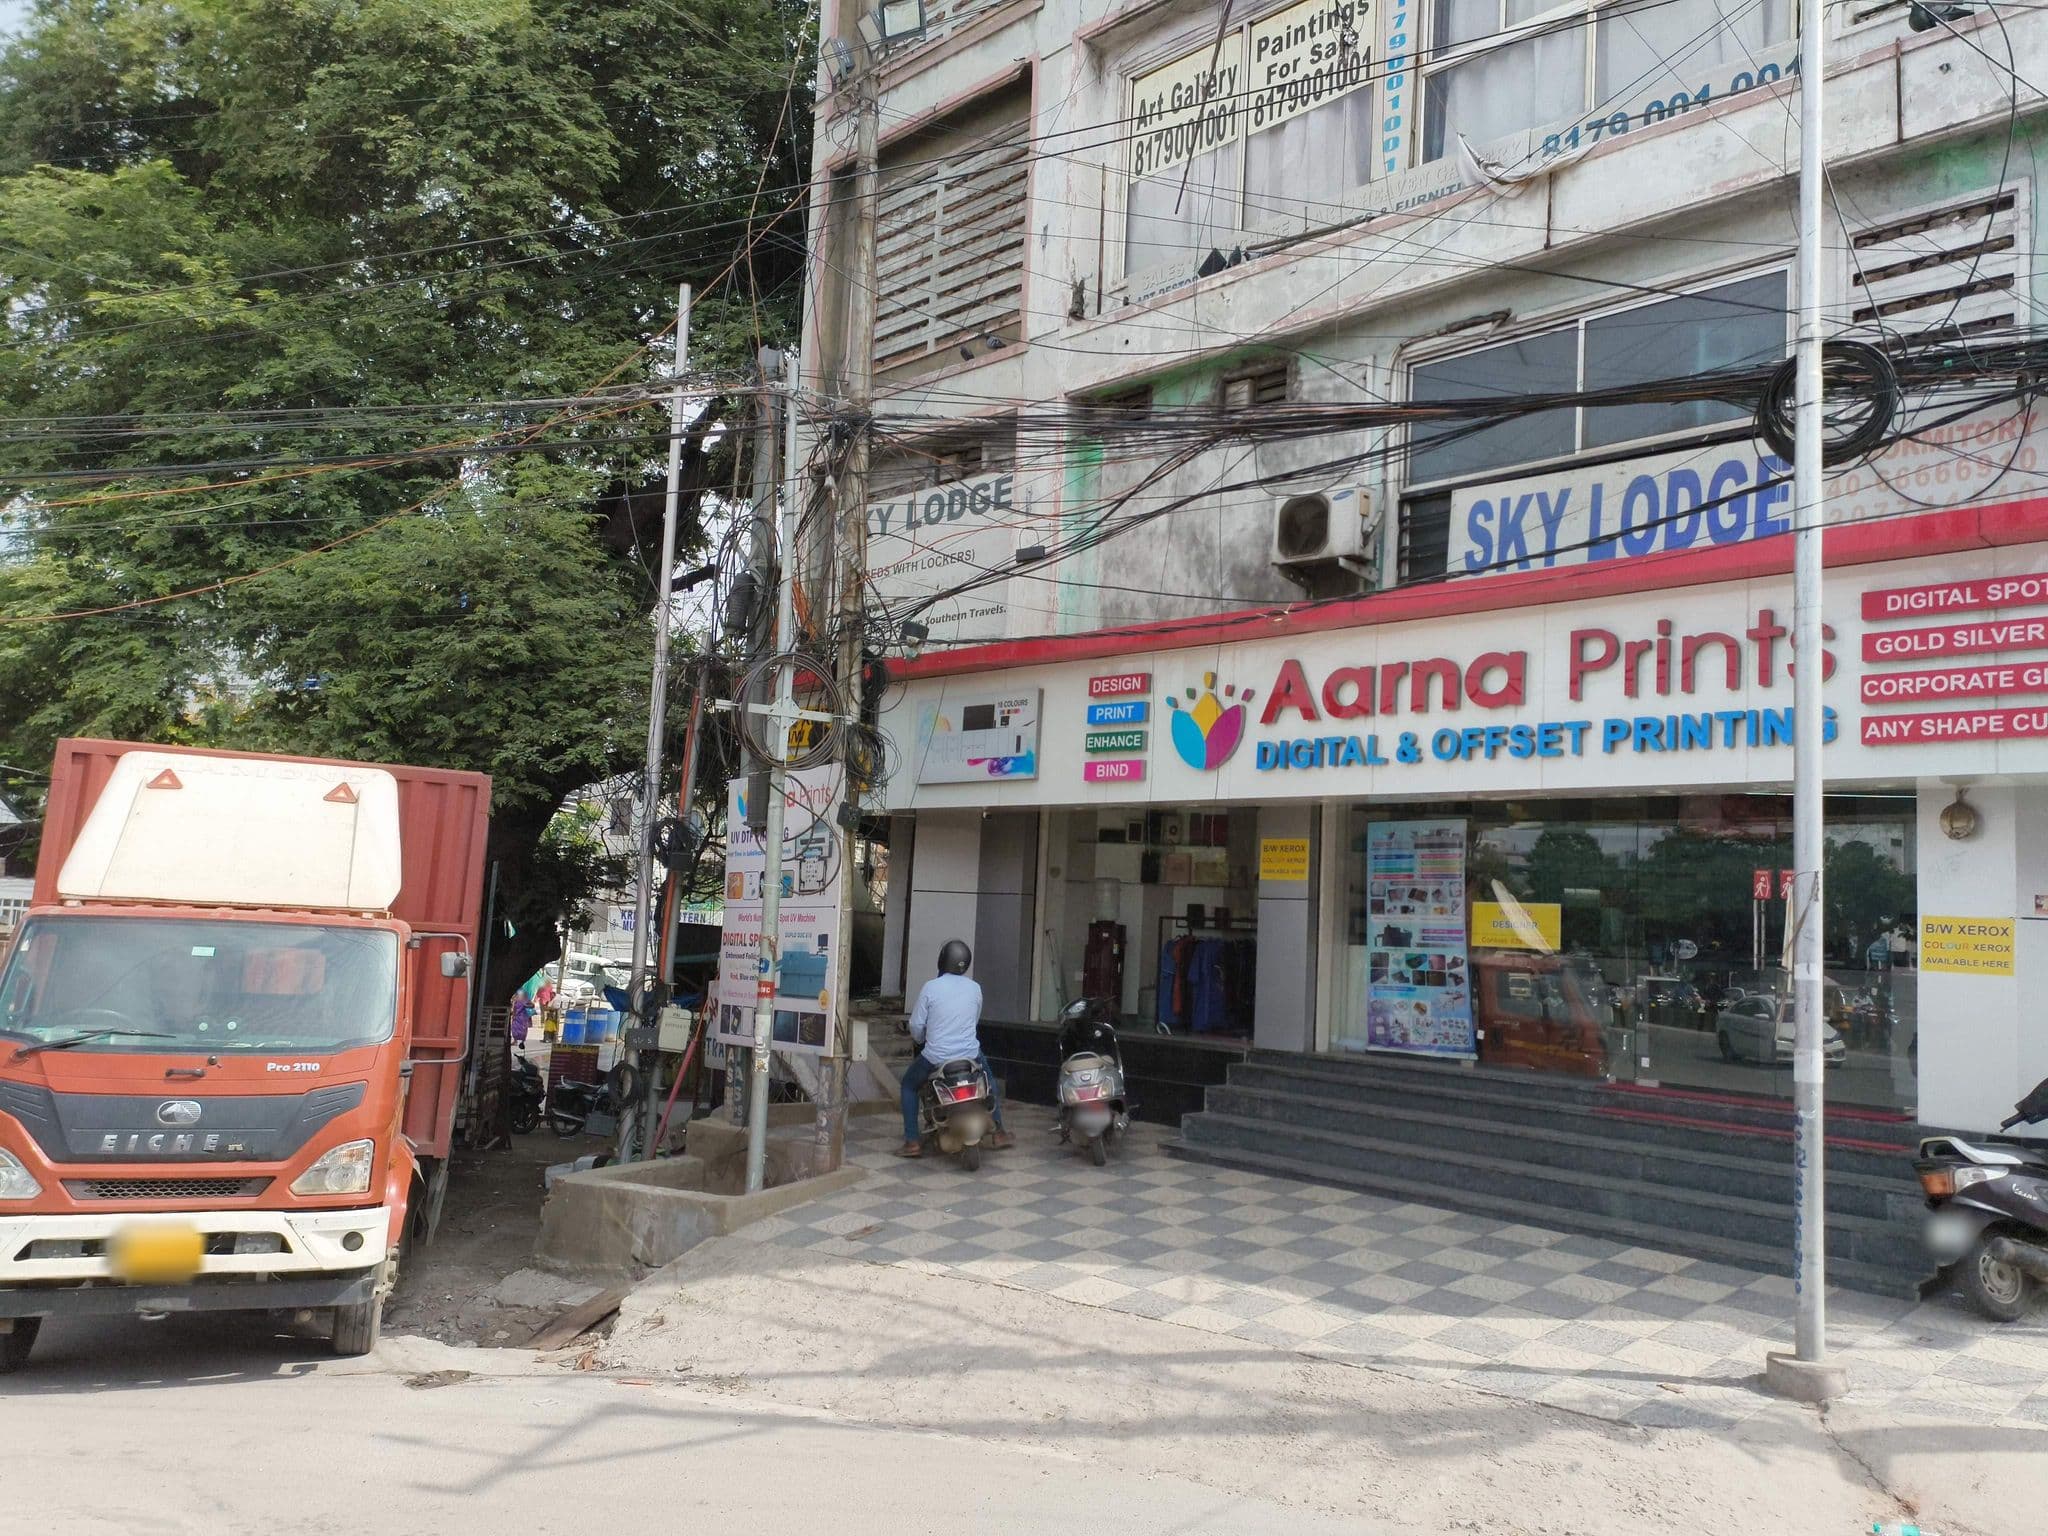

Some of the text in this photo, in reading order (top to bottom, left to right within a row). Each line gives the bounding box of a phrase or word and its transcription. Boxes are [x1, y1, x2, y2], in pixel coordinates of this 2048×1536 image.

[1256, 0, 1369, 63] Paintings
[1266, 57, 1301, 85] For
[1254, 46, 1371, 127] 8179001001
[1136, 91, 1163, 131] Art
[1135, 98, 1237, 176] 8179001001
[905, 475, 1015, 531] LODGE
[1465, 487, 1571, 576] SKY
[1588, 454, 1791, 561] LODGE
[893, 561, 918, 574] WITH
[1886, 588, 1979, 612] DIGITAL
[925, 611, 967, 626] Southern
[1875, 623, 2045, 654] GOLD SILVER
[1092, 676, 1141, 693] DESIGN
[1260, 650, 1527, 724] Aarna
[1863, 670, 2015, 697] CORPORATE
[1096, 705, 1135, 721] PRINT
[1865, 720, 1914, 739] ANY
[1920, 715, 2004, 736] SHAPE
[1087, 734, 1141, 750] ENHANCE
[1256, 734, 1388, 772] DIGITAL
[1399, 732, 1422, 763] &
[1432, 720, 1592, 761] OFFSET
[1096, 763, 1129, 778] BIND
[800, 784, 832, 806] Prints
[730, 831, 740, 844] UV
[680, 912, 706, 923] TERN
[722, 932, 746, 947] DIGITAL
[1925, 923, 2010, 937] B/W XEROX
[1924, 941, 2011, 953] COLOUR XEROX
[1925, 956, 2010, 969] AVAILABLE HERE
[266, 1063, 321, 1072] Pro 2110
